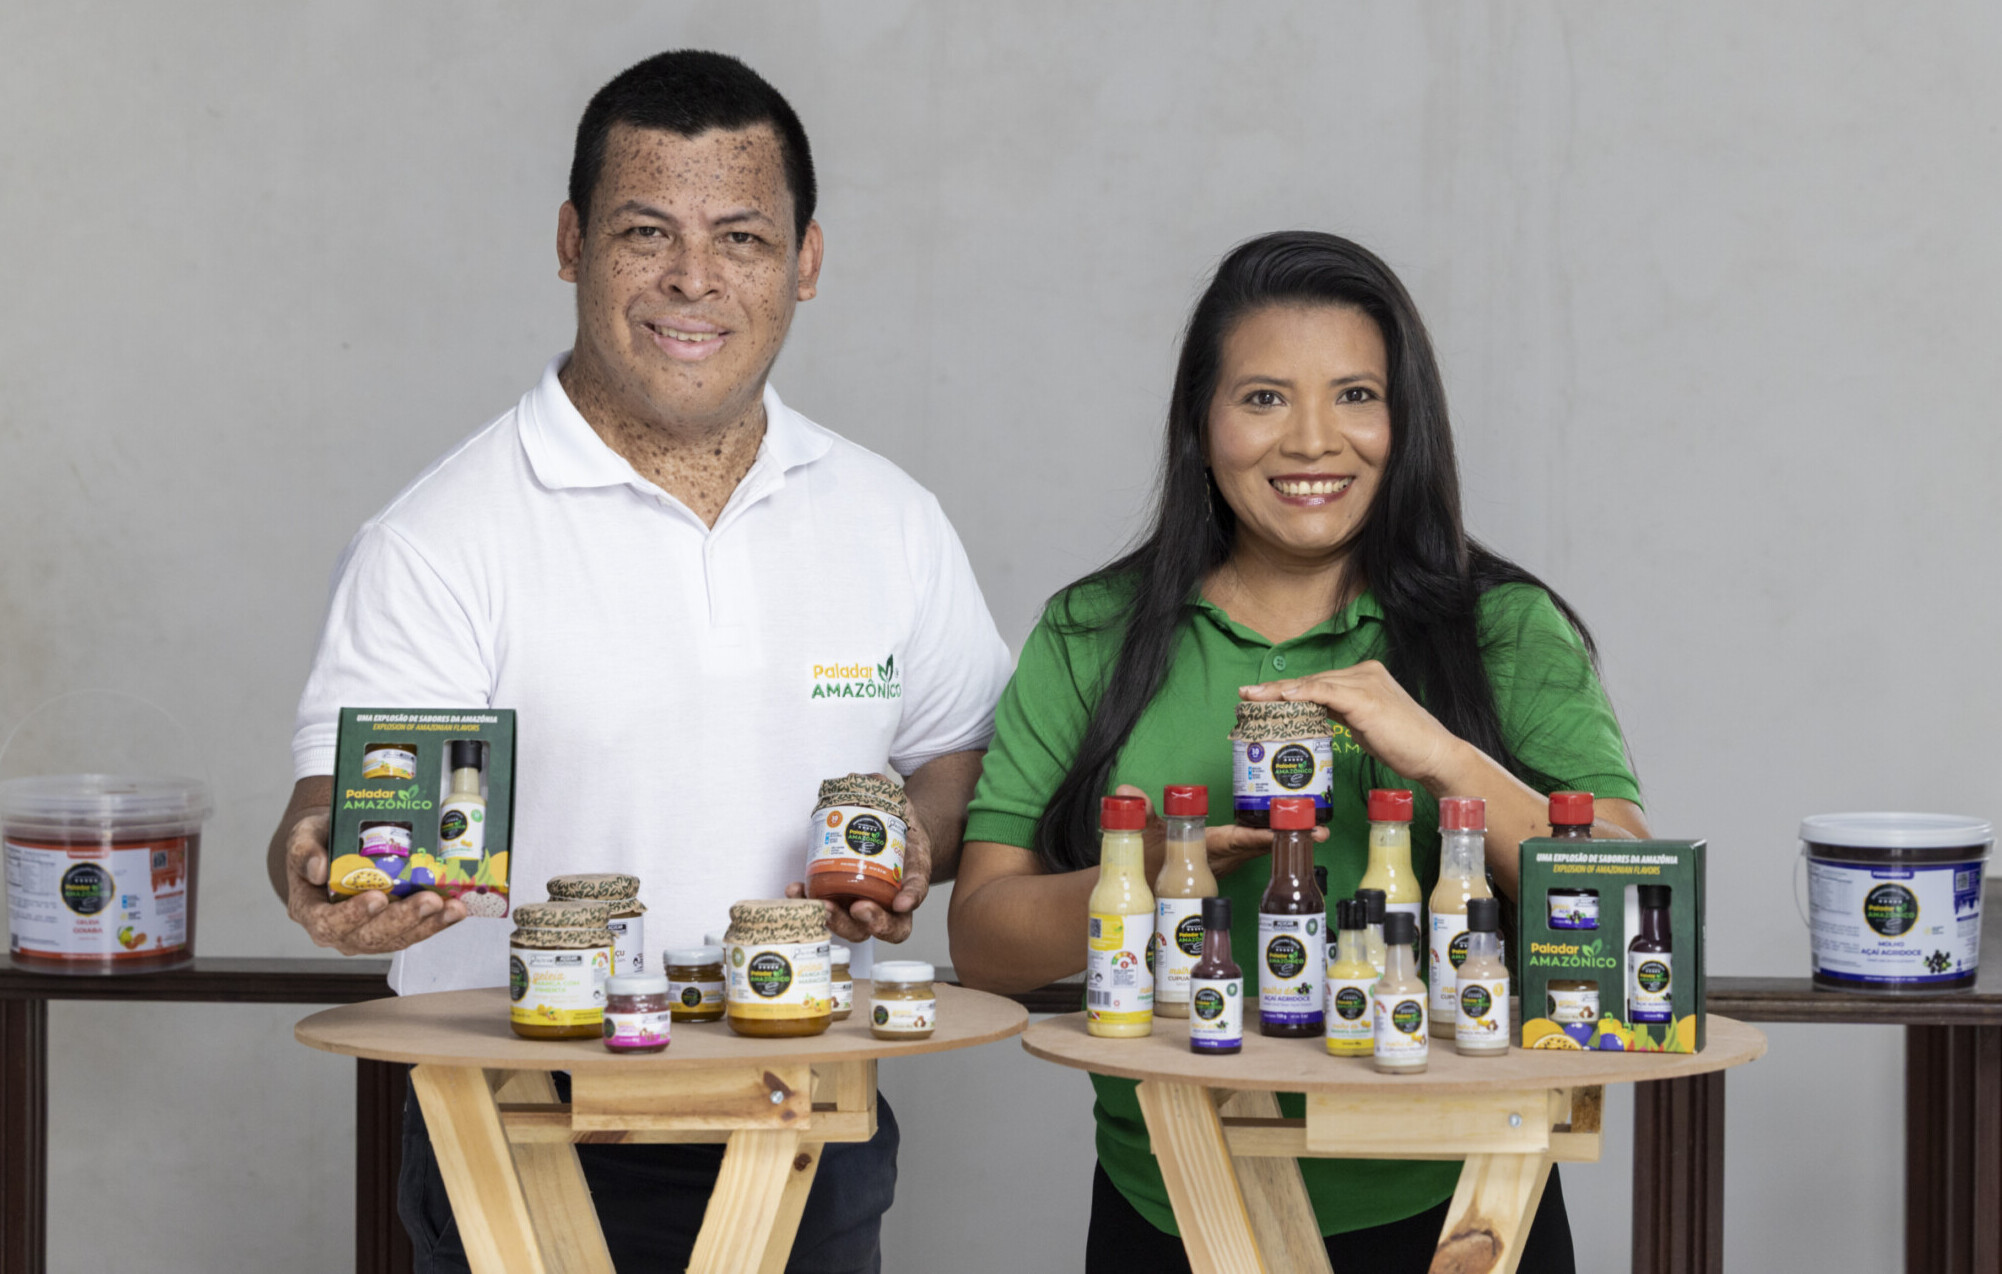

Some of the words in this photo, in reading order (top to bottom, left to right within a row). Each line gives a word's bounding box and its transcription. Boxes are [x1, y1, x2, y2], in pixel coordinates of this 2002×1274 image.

[813, 662, 873, 679] Paladar
[811, 678, 902, 699] AMAZÔNICO
[374, 714, 408, 722] EXPLOSÃO
[419, 715, 449, 723] SABORES
[460, 714, 498, 723] AMAZÔNIA
[373, 723, 405, 731] EXPLOSION
[416, 724, 453, 732] AMAZONIAN
[1275, 767, 1313, 775] AMAZÔNICO
[345, 788, 396, 799] Paladar
[342, 797, 433, 810] AMAZÔNICO
[1536, 853, 1553, 861] UMA
[1553, 852, 1588, 862] EXPLOSÃO
[1588, 854, 1598, 863] DE
[1598, 854, 1630, 863] SABORES
[1630, 855, 1640, 863] DA
[1641, 853, 1678, 864] AMAZÔNIA
[1553, 864, 1586, 873] EXPLOSION
[1587, 865, 1595, 873] OF
[1595, 865, 1633, 874] AMAZONIAN
[1634, 866, 1661, 875] FLAVORS
[1531, 942, 1579, 954] Paladar
[1861, 947, 1880, 956] AÇAÍ
[1529, 954, 1617, 969] AMAZÔNICO
